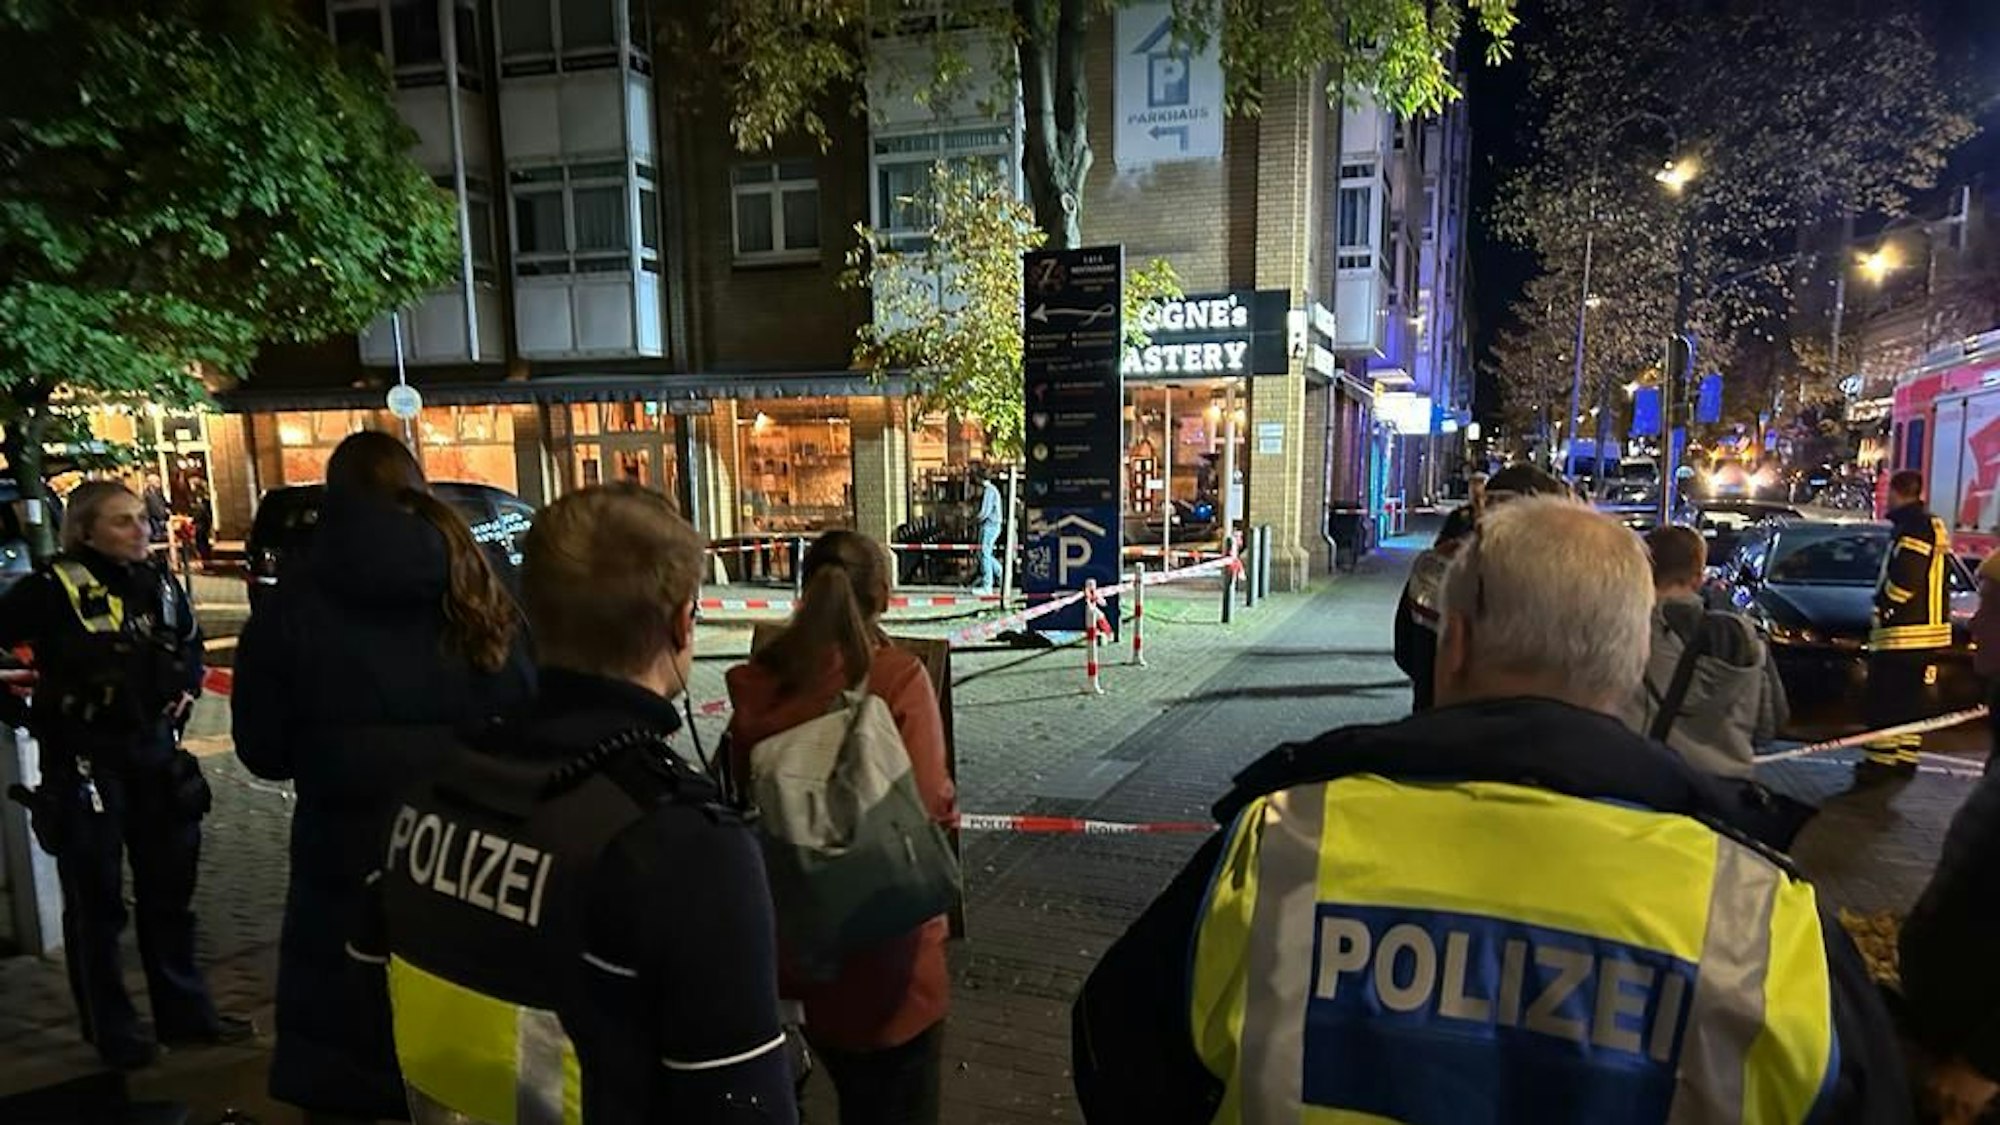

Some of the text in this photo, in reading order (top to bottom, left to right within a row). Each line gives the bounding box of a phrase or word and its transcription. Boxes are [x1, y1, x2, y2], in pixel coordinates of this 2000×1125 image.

[1127, 107, 1210, 125] PARKHAUS
[1058, 535, 1092, 586] P
[387, 805, 554, 927] POLIZEI
[1315, 916, 1685, 1062] POLIZEI
